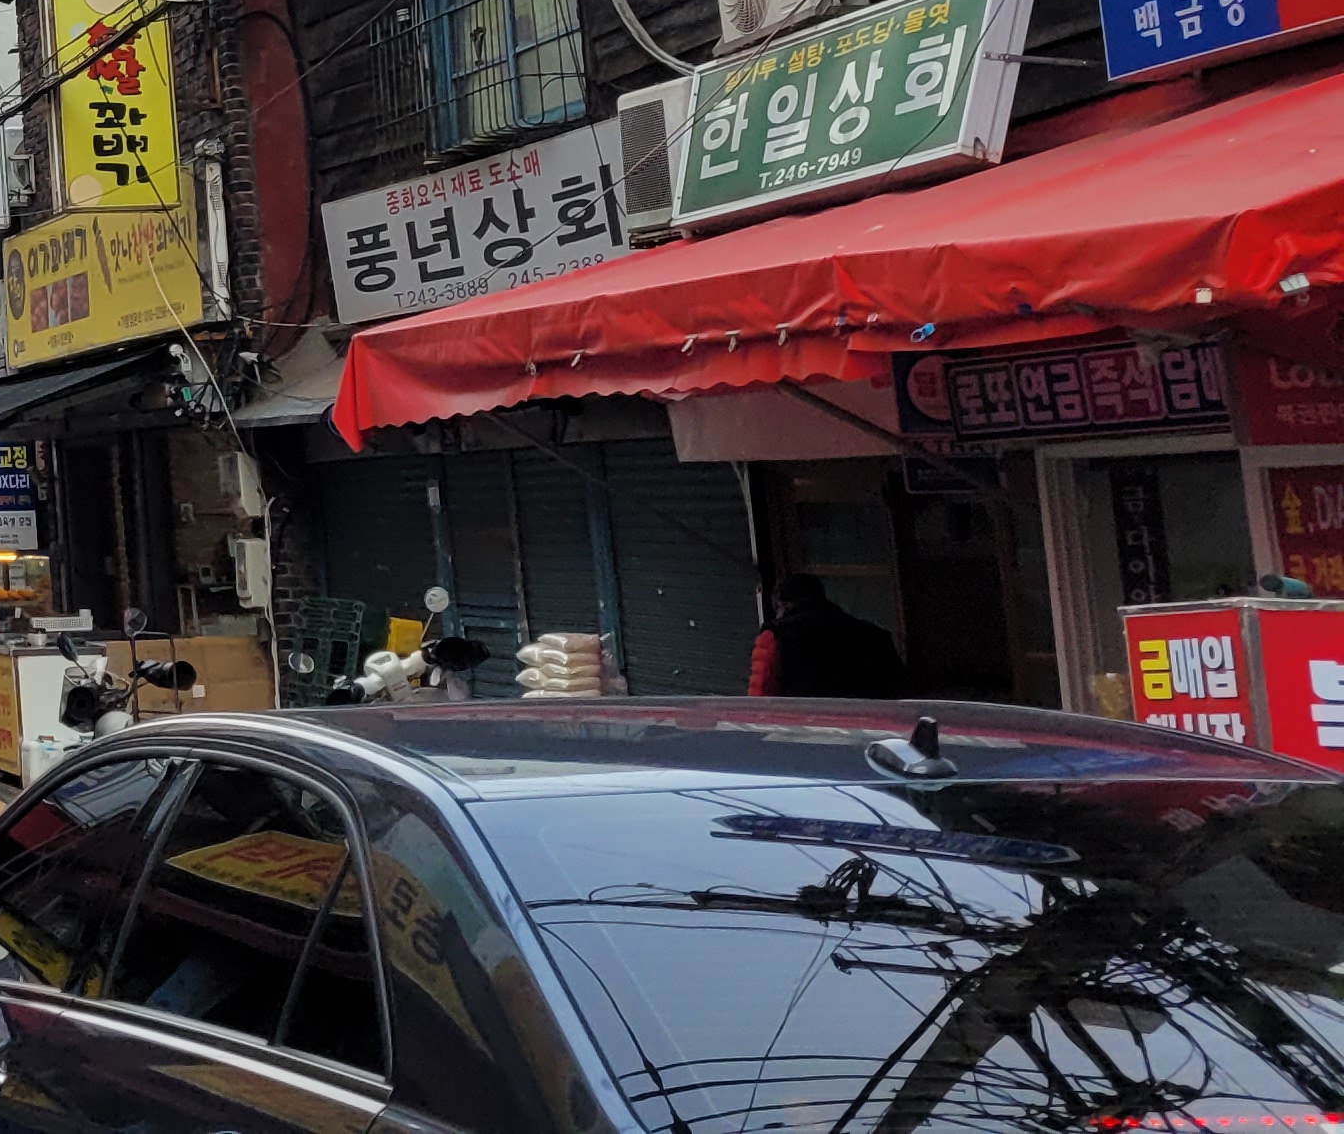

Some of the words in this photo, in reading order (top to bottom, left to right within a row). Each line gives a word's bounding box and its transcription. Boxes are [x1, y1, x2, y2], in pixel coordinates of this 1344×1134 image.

[89, 102, 150, 186] 꽈배기
[700, 25, 967, 180] 한일상회
[489, 150, 541, 185] 도소매
[759, 147, 862, 189] T.246-7949
[345, 163, 623, 293] 풍년상회
